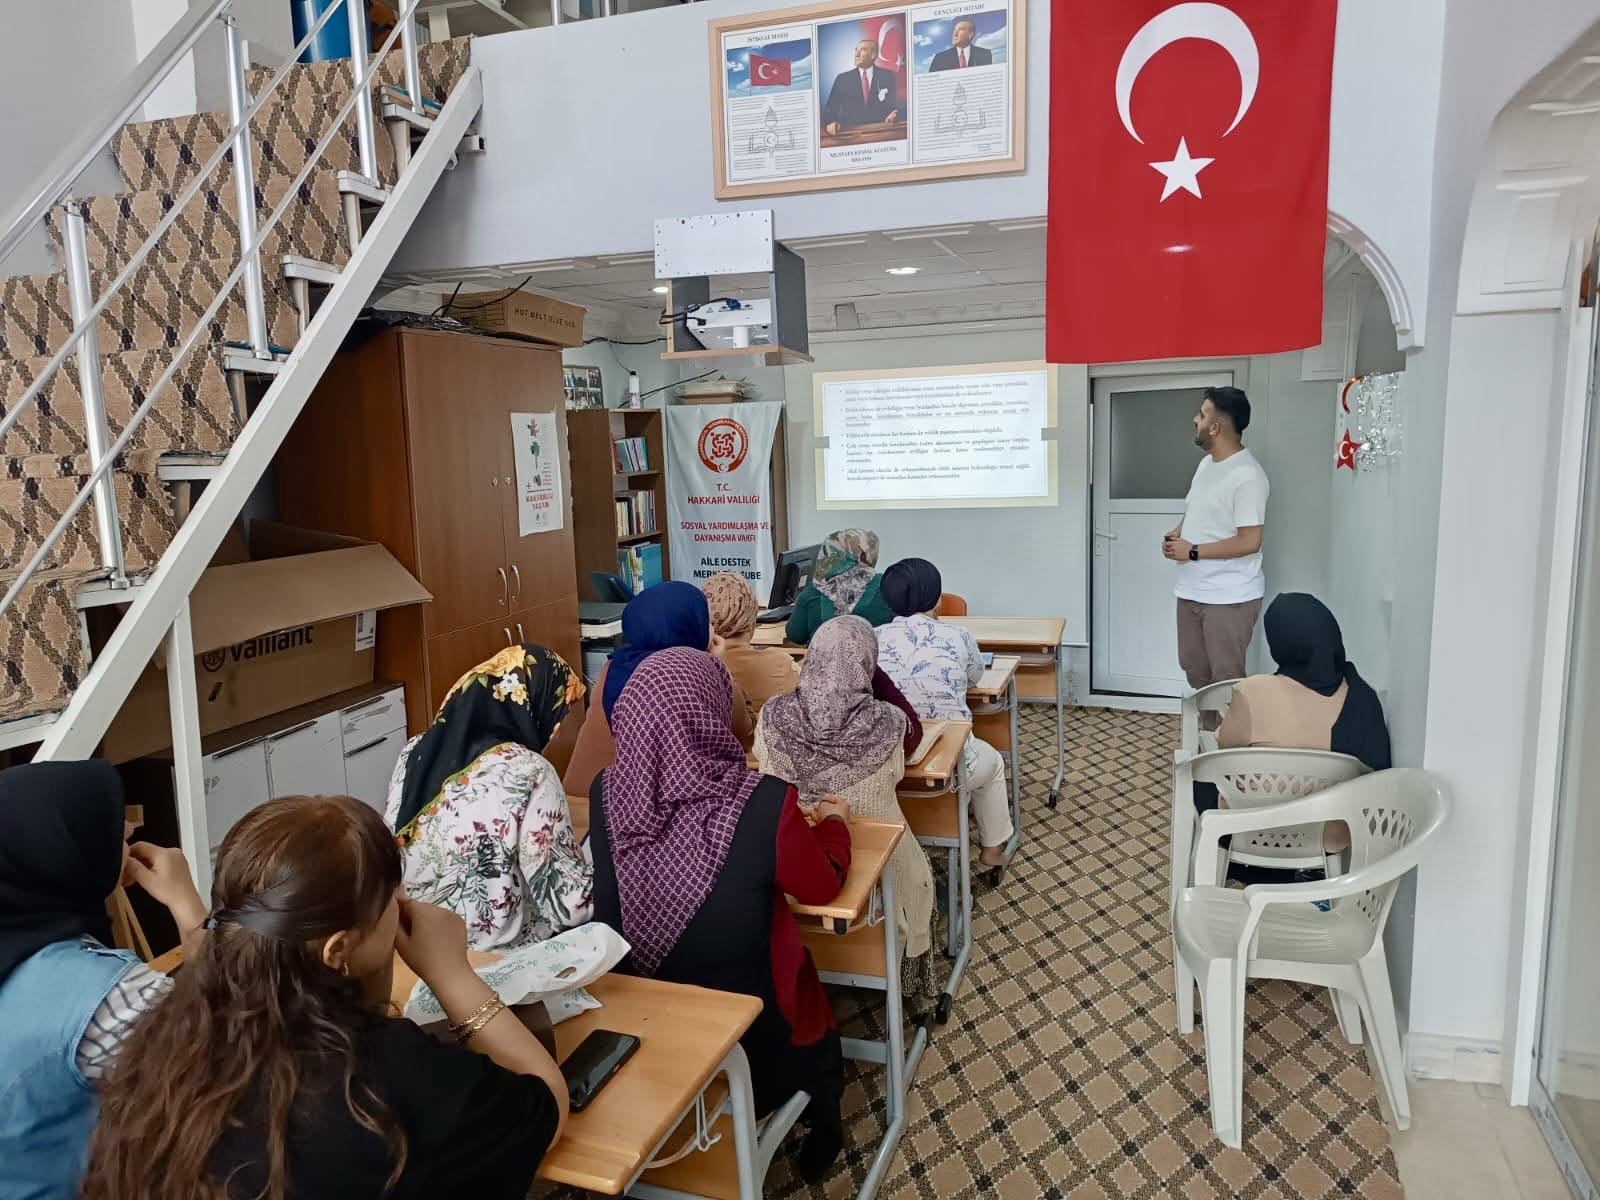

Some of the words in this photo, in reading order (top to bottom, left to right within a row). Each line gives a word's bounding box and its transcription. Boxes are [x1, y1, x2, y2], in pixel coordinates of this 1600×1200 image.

[716, 483, 732, 492] T.C.
[687, 494, 726, 505] HAKKARİ
[727, 493, 761, 504] VALİLİĞİ
[680, 522, 707, 530] SOSYAL
[708, 522, 759, 532] YARDIMLAŞMA
[760, 522, 769, 530] VE
[694, 534, 736, 543] DAYANIŞMA
[737, 534, 756, 542] VAKFI
[701, 556, 719, 567] AİLE
[720, 557, 752, 567] DESTEK
